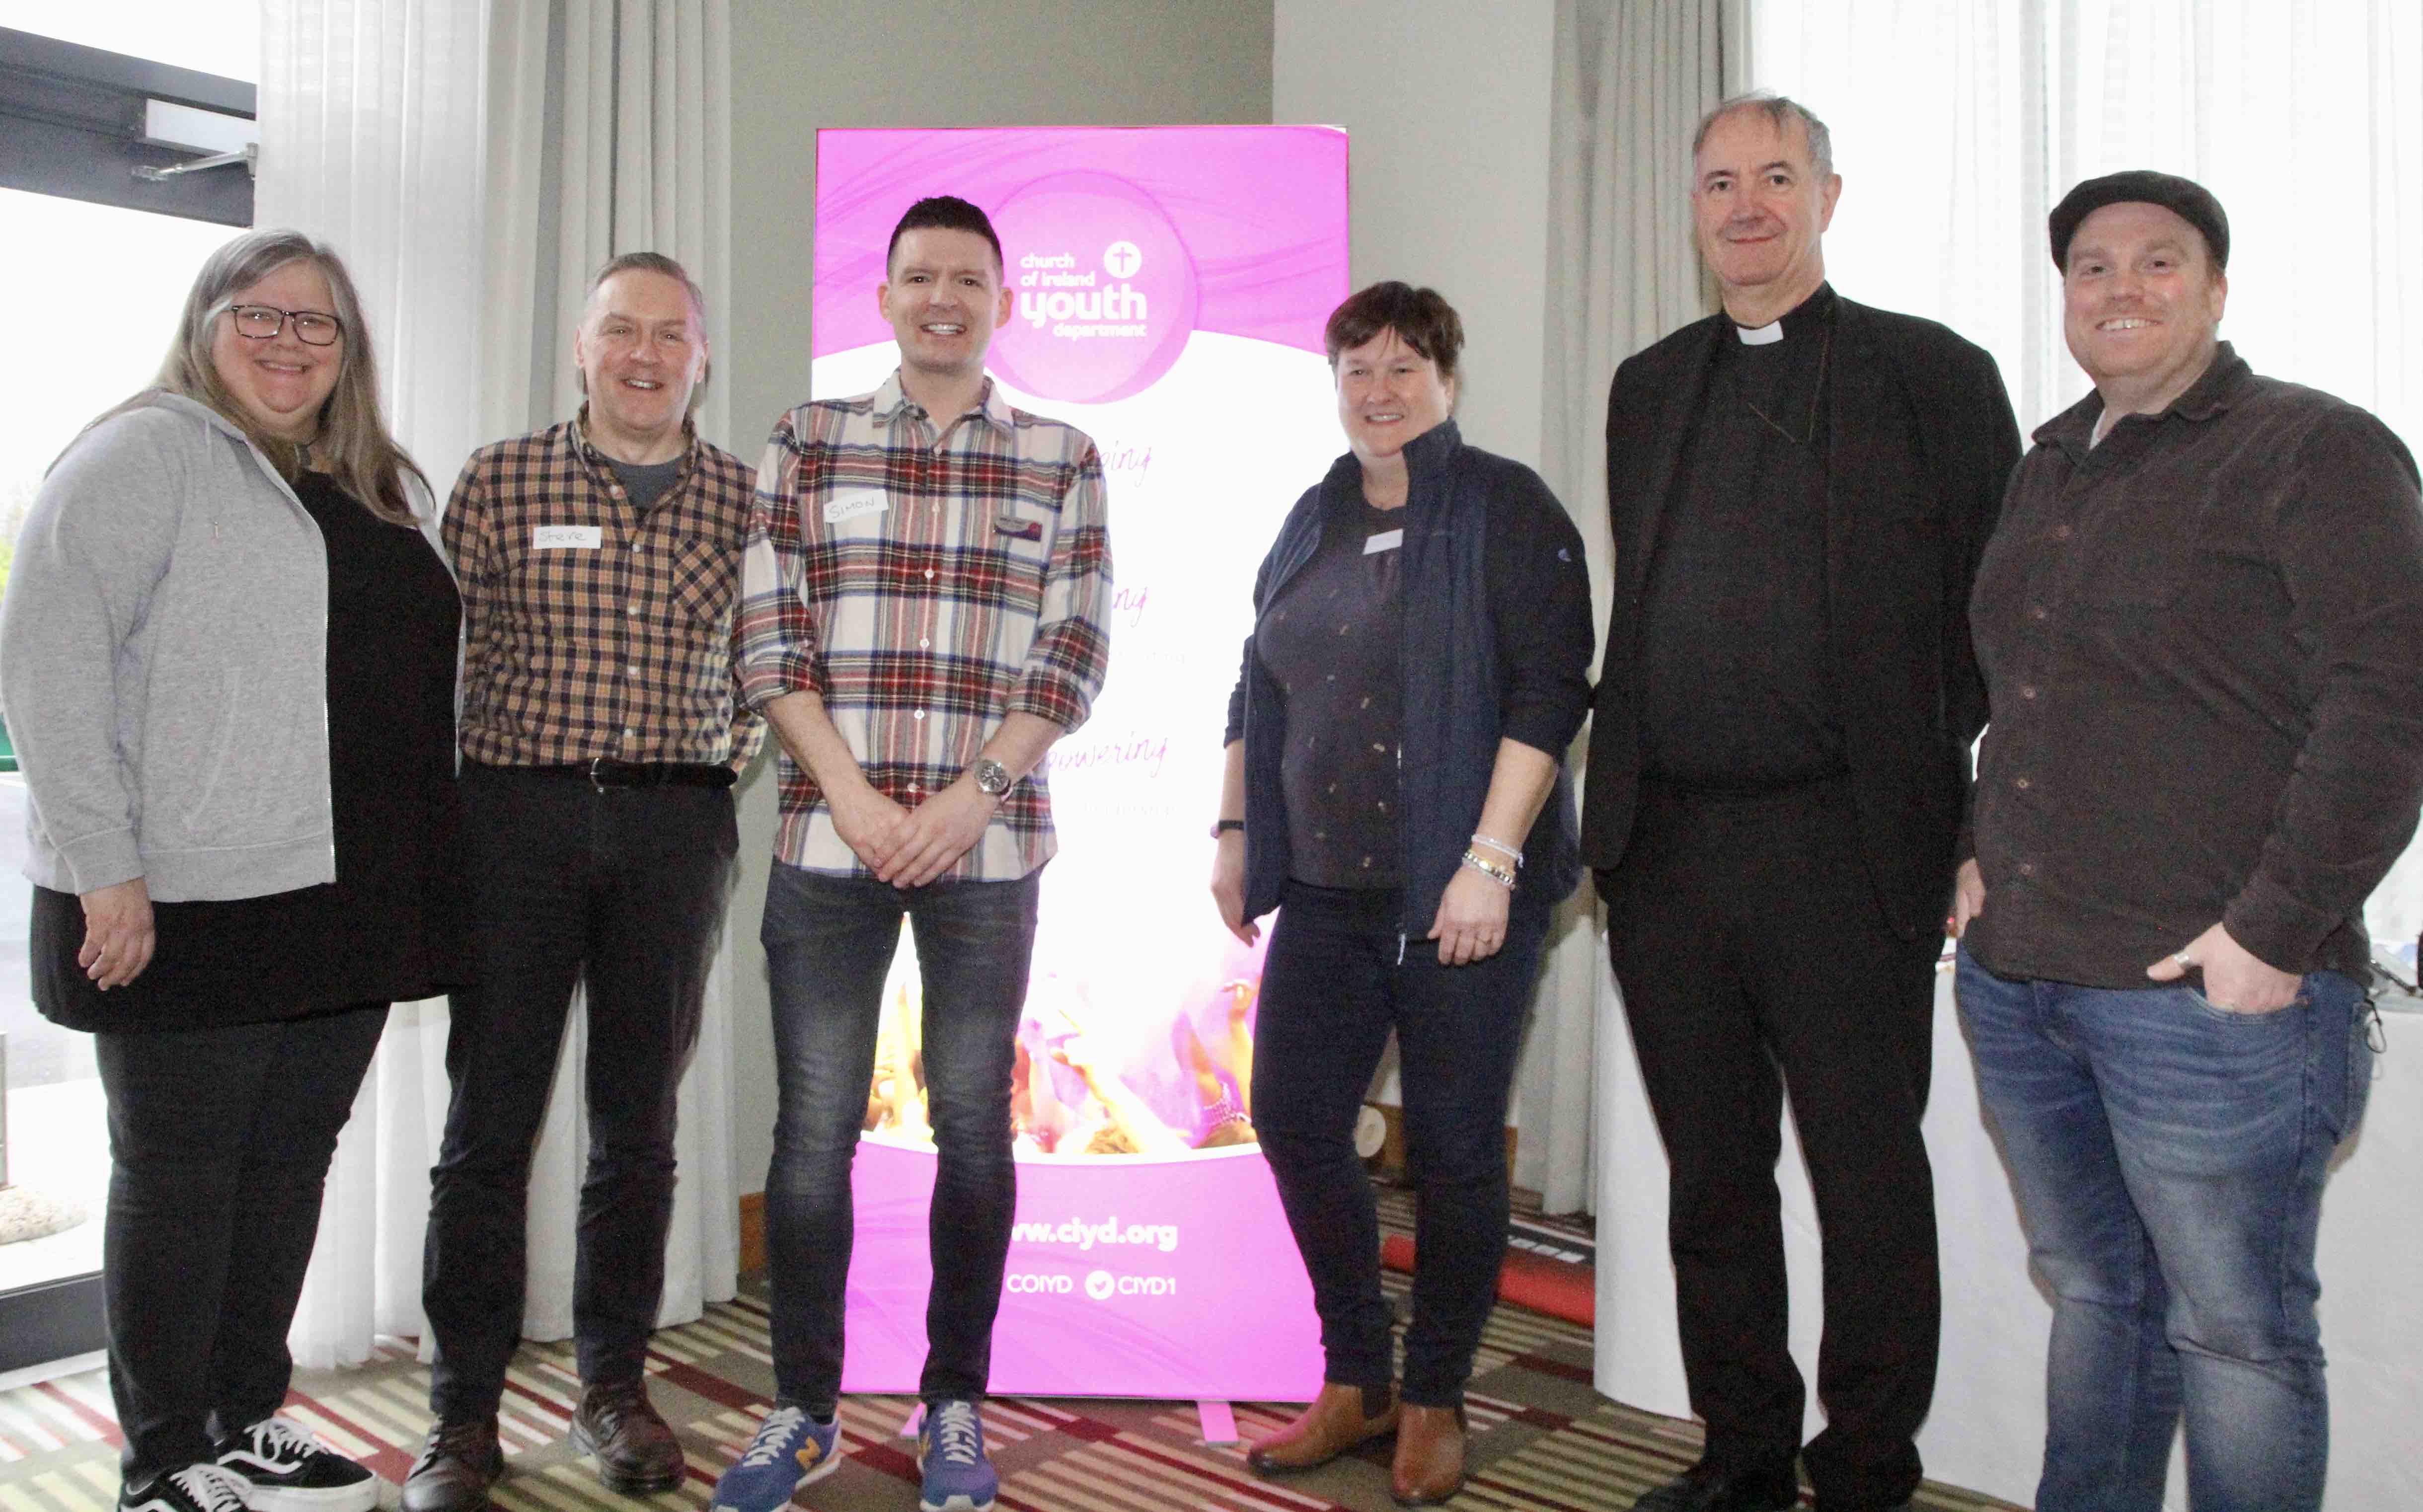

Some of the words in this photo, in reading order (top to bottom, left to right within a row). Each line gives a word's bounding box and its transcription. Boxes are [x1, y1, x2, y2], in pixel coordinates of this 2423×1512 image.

[1020, 252, 1075, 268] church
[1021, 271, 1039, 287] of
[1020, 284, 1147, 328] youth
[1053, 323, 1147, 341] department
[829, 496, 874, 519] SIMON
[1006, 1274, 1072, 1293] COIYD
[1118, 1276, 1176, 1294] CIYD1
